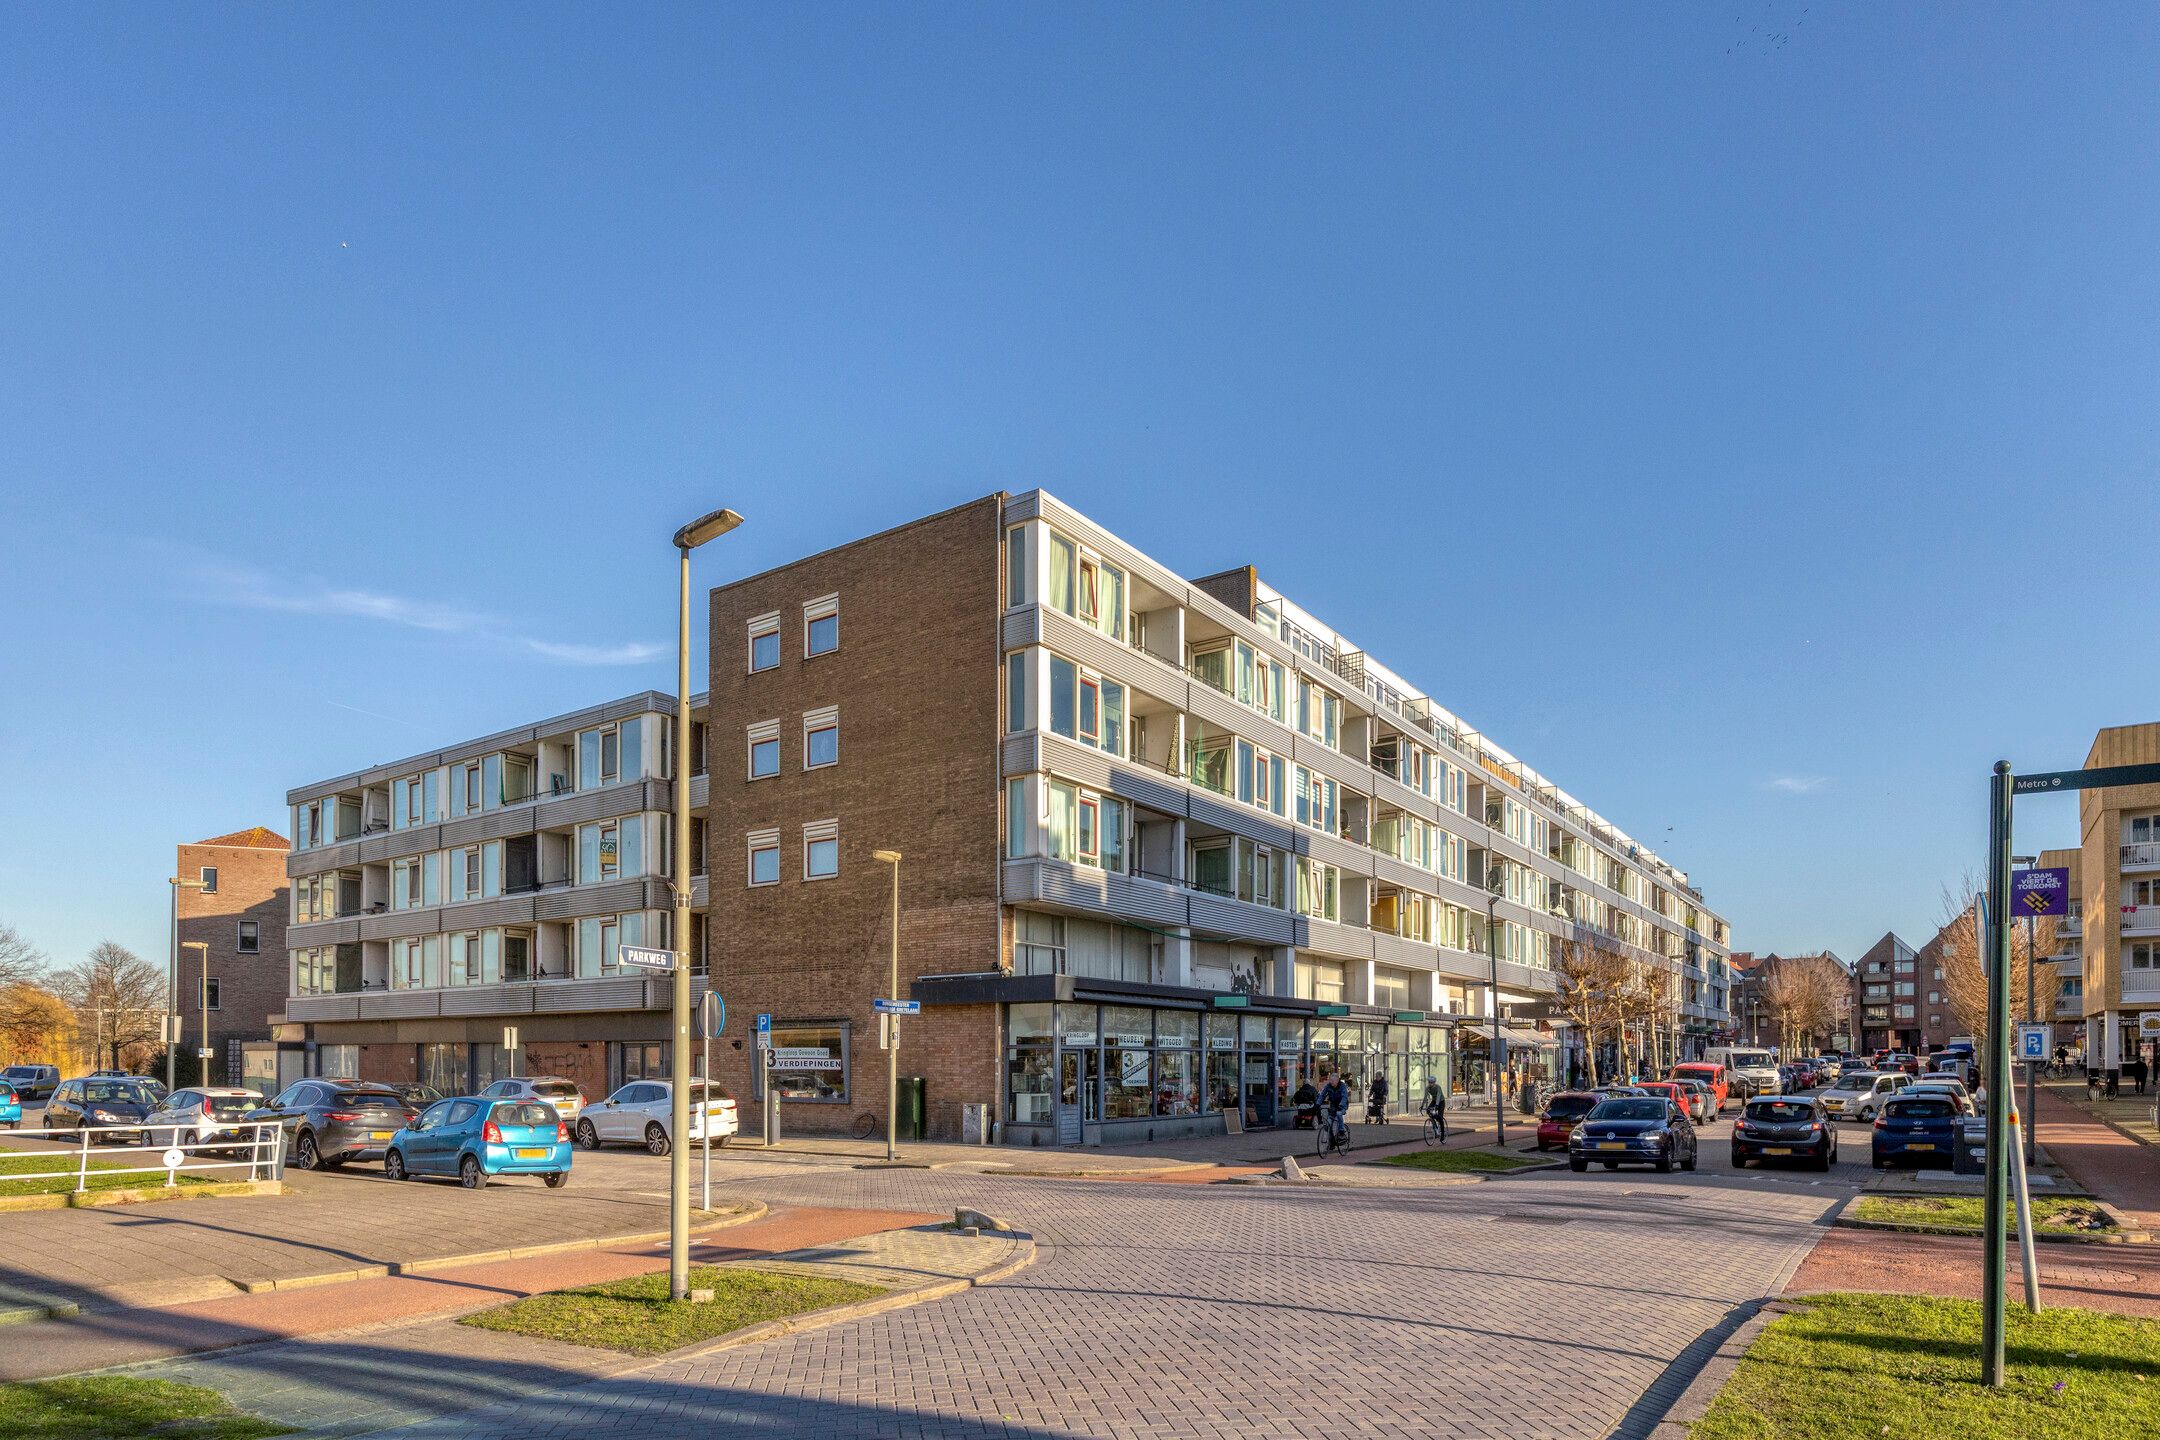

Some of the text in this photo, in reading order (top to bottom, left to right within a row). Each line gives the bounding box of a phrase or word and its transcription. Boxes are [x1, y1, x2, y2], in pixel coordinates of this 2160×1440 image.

[2017, 780, 2048, 790] Metro
[2026, 872, 2052, 880] S'DAM
[2017, 882, 2062, 890] TOEKOMST
[628, 949, 667, 966] PARKWEG
[1548, 1005, 1604, 1015] PAKFAT
[760, 1016, 767, 1031] P
[1118, 1035, 1144, 1044] MEUBELS
[1159, 1038, 1182, 1046] WITGOED
[1213, 1039, 1232, 1047] KLEDING
[1281, 1040, 1298, 1048] KASTEN
[2027, 1036, 2039, 1048] P
[767, 1049, 841, 1068] 3 VERDIEPINGEN
[1124, 1052, 1134, 1068] 3
